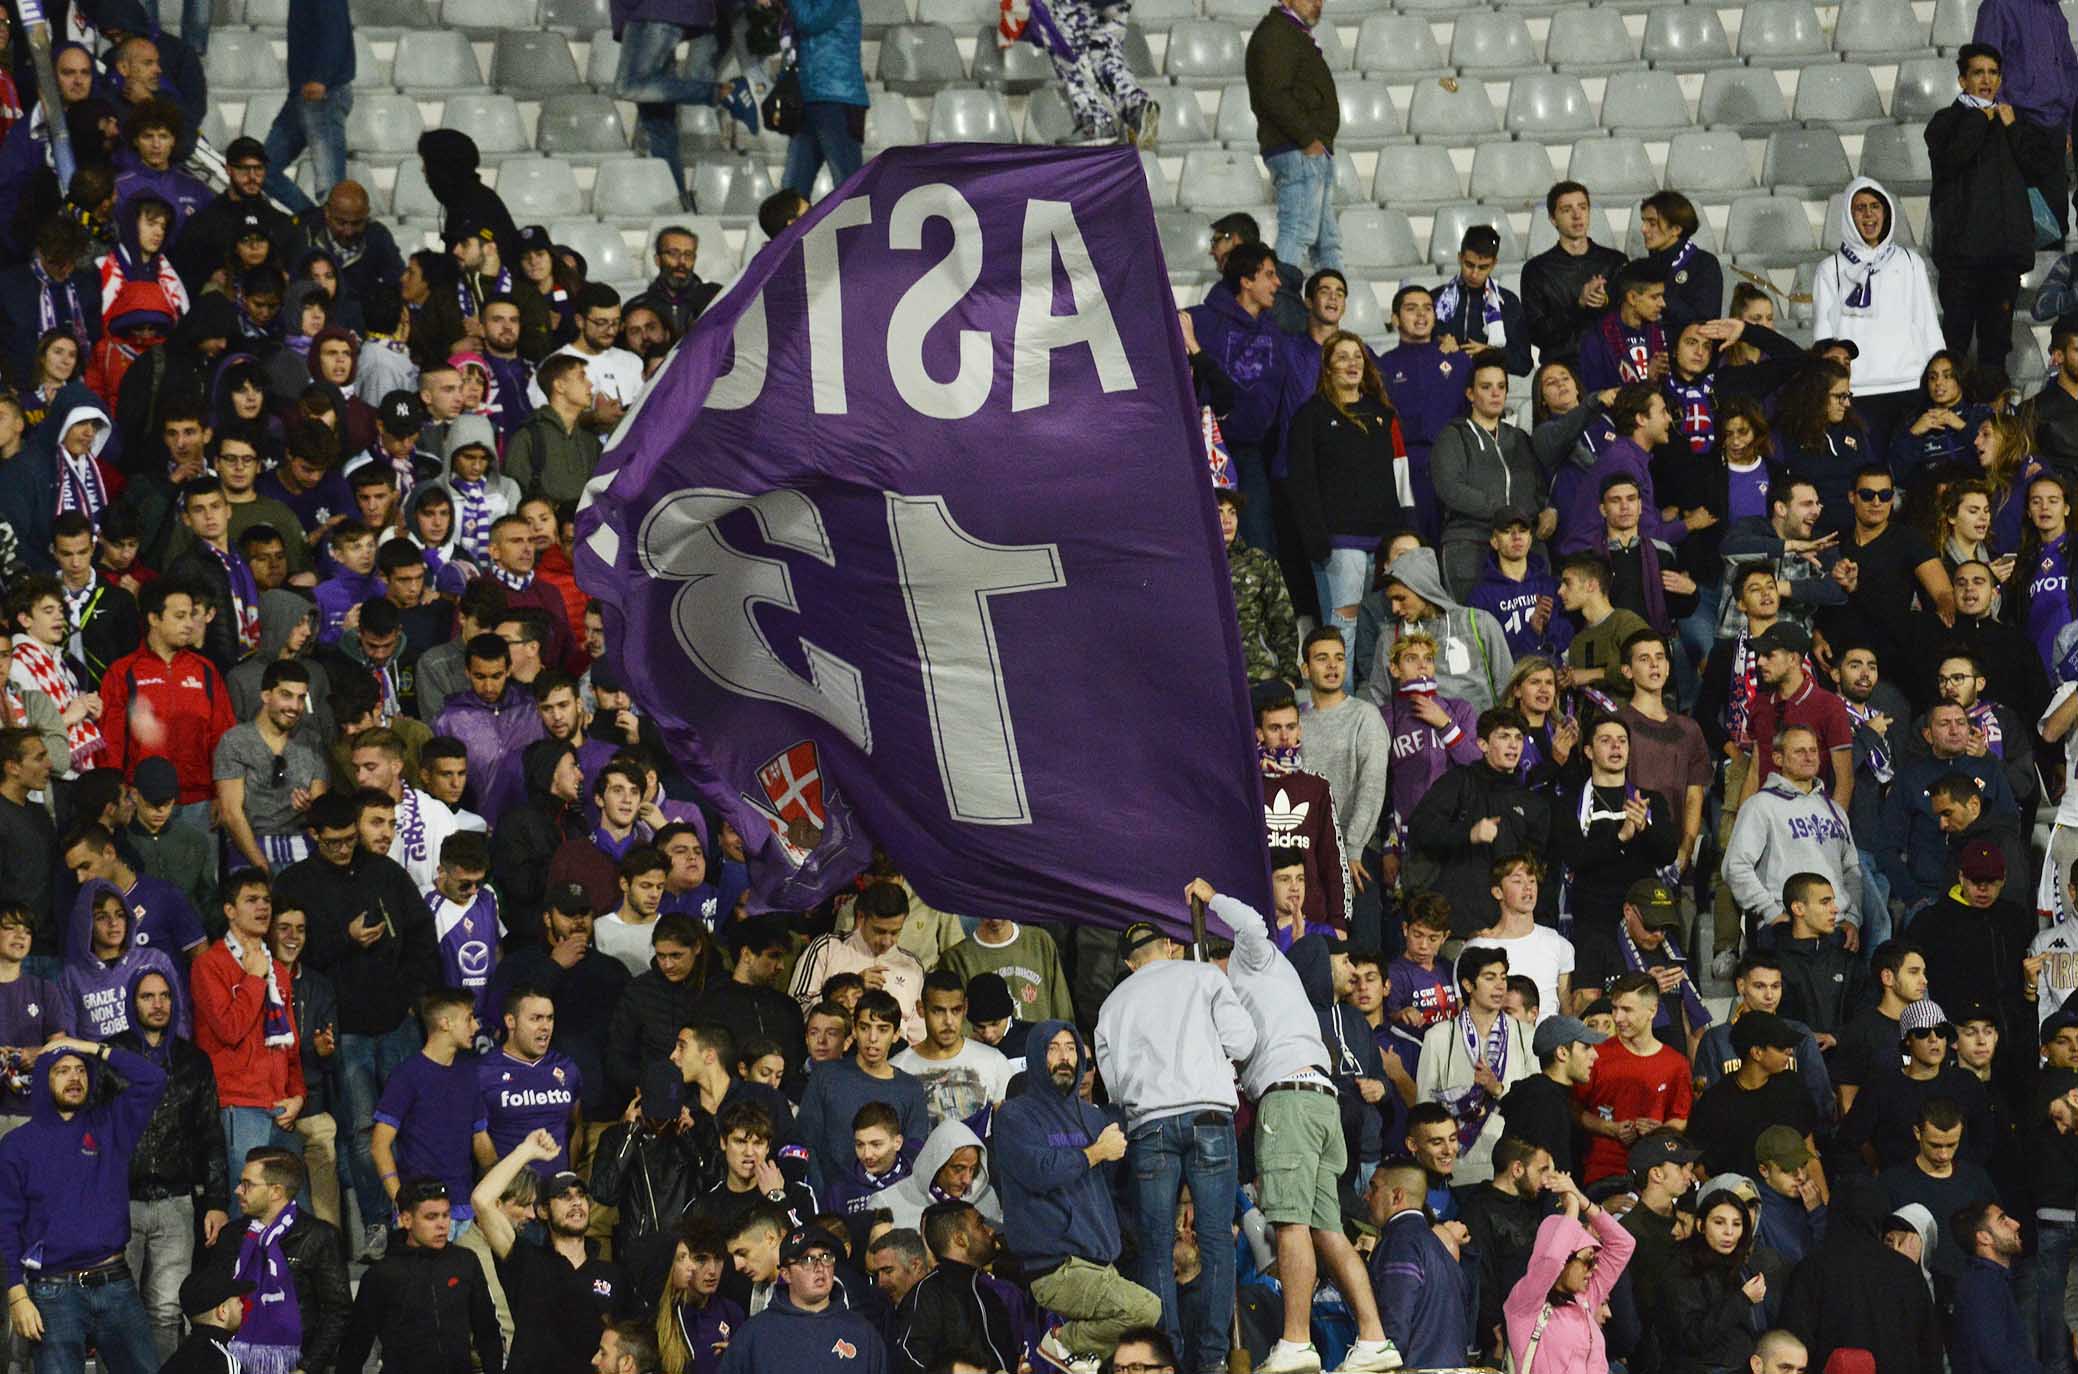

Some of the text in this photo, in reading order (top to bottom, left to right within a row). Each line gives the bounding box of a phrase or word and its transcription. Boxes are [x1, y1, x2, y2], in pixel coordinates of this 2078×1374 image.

[1267, 832, 1310, 849] didas
[83, 988, 118, 1009] GRAZIE
[90, 1000, 126, 1024] NON S
[501, 1088, 571, 1108] folletto
